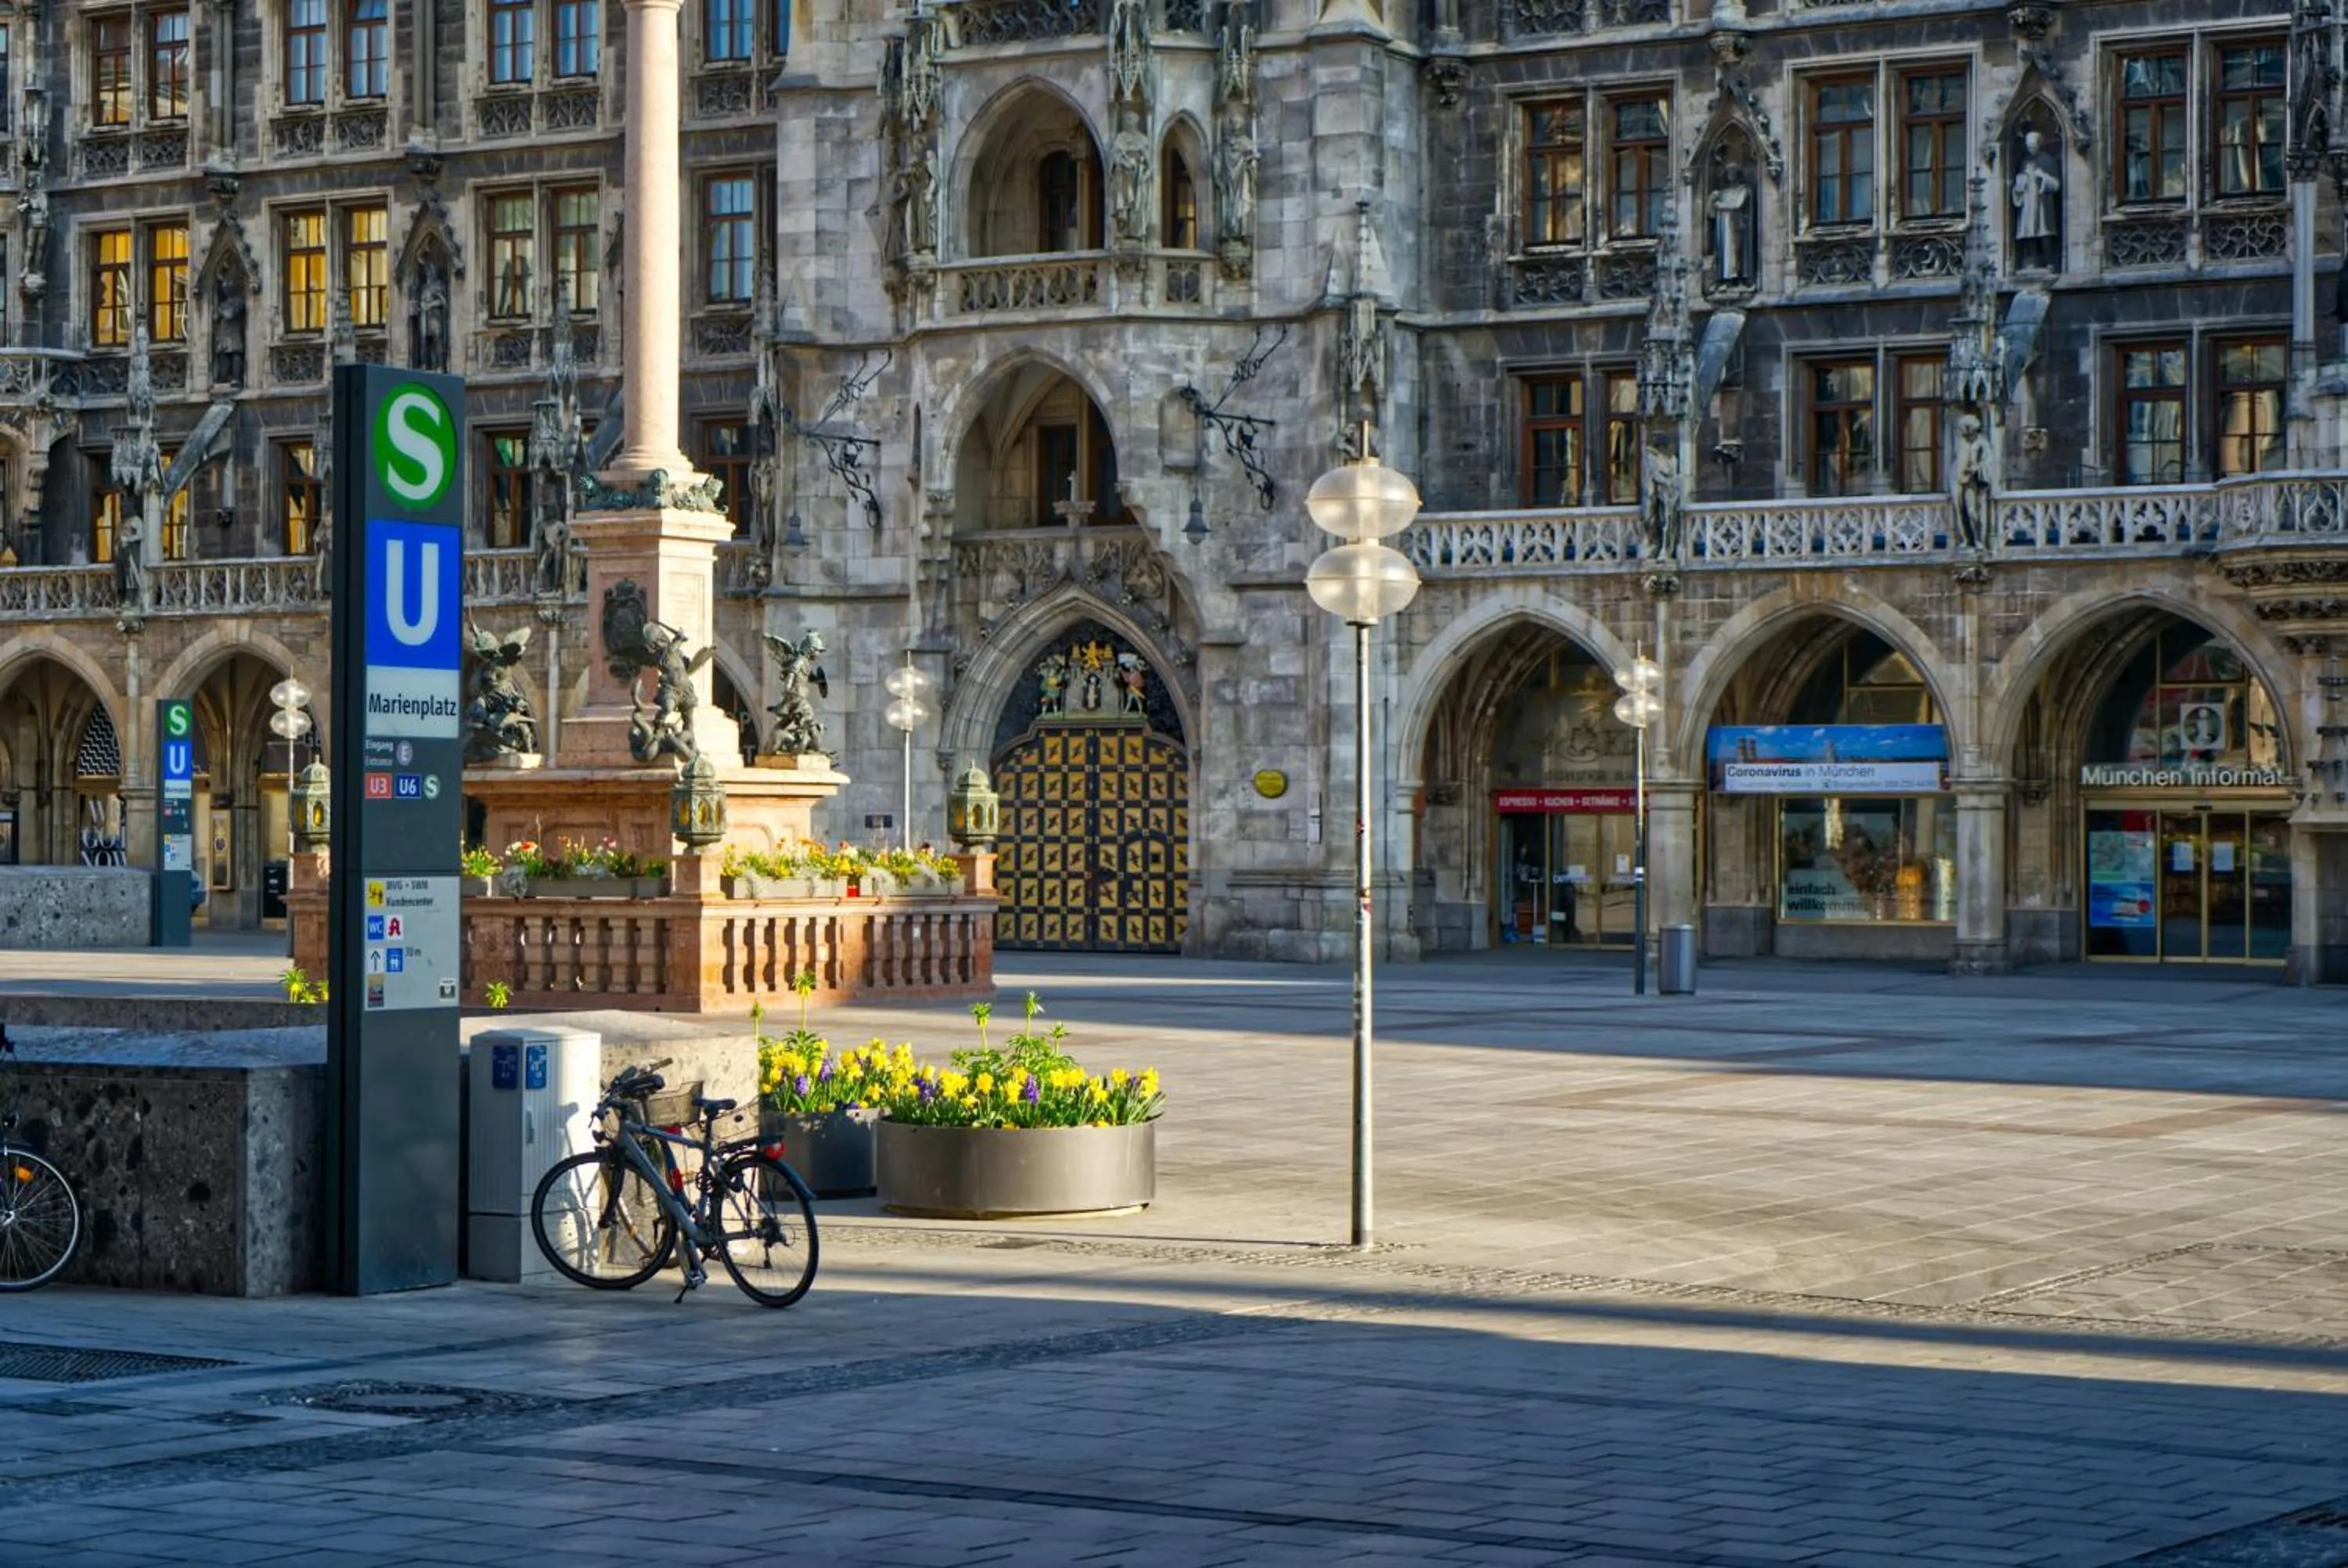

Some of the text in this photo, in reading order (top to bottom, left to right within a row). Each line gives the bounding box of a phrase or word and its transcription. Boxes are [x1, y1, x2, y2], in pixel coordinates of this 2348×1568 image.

[387, 392, 444, 501] S
[386, 539, 440, 646] U
[169, 705, 187, 735] S
[369, 692, 456, 721] Marienplatz
[169, 745, 185, 775] U
[1727, 765, 1875, 778] Coronavirus in München
[369, 776, 438, 797] U3 U6 S
[2081, 765, 2284, 786] München Informat
[1787, 882, 1836, 895] einfach
